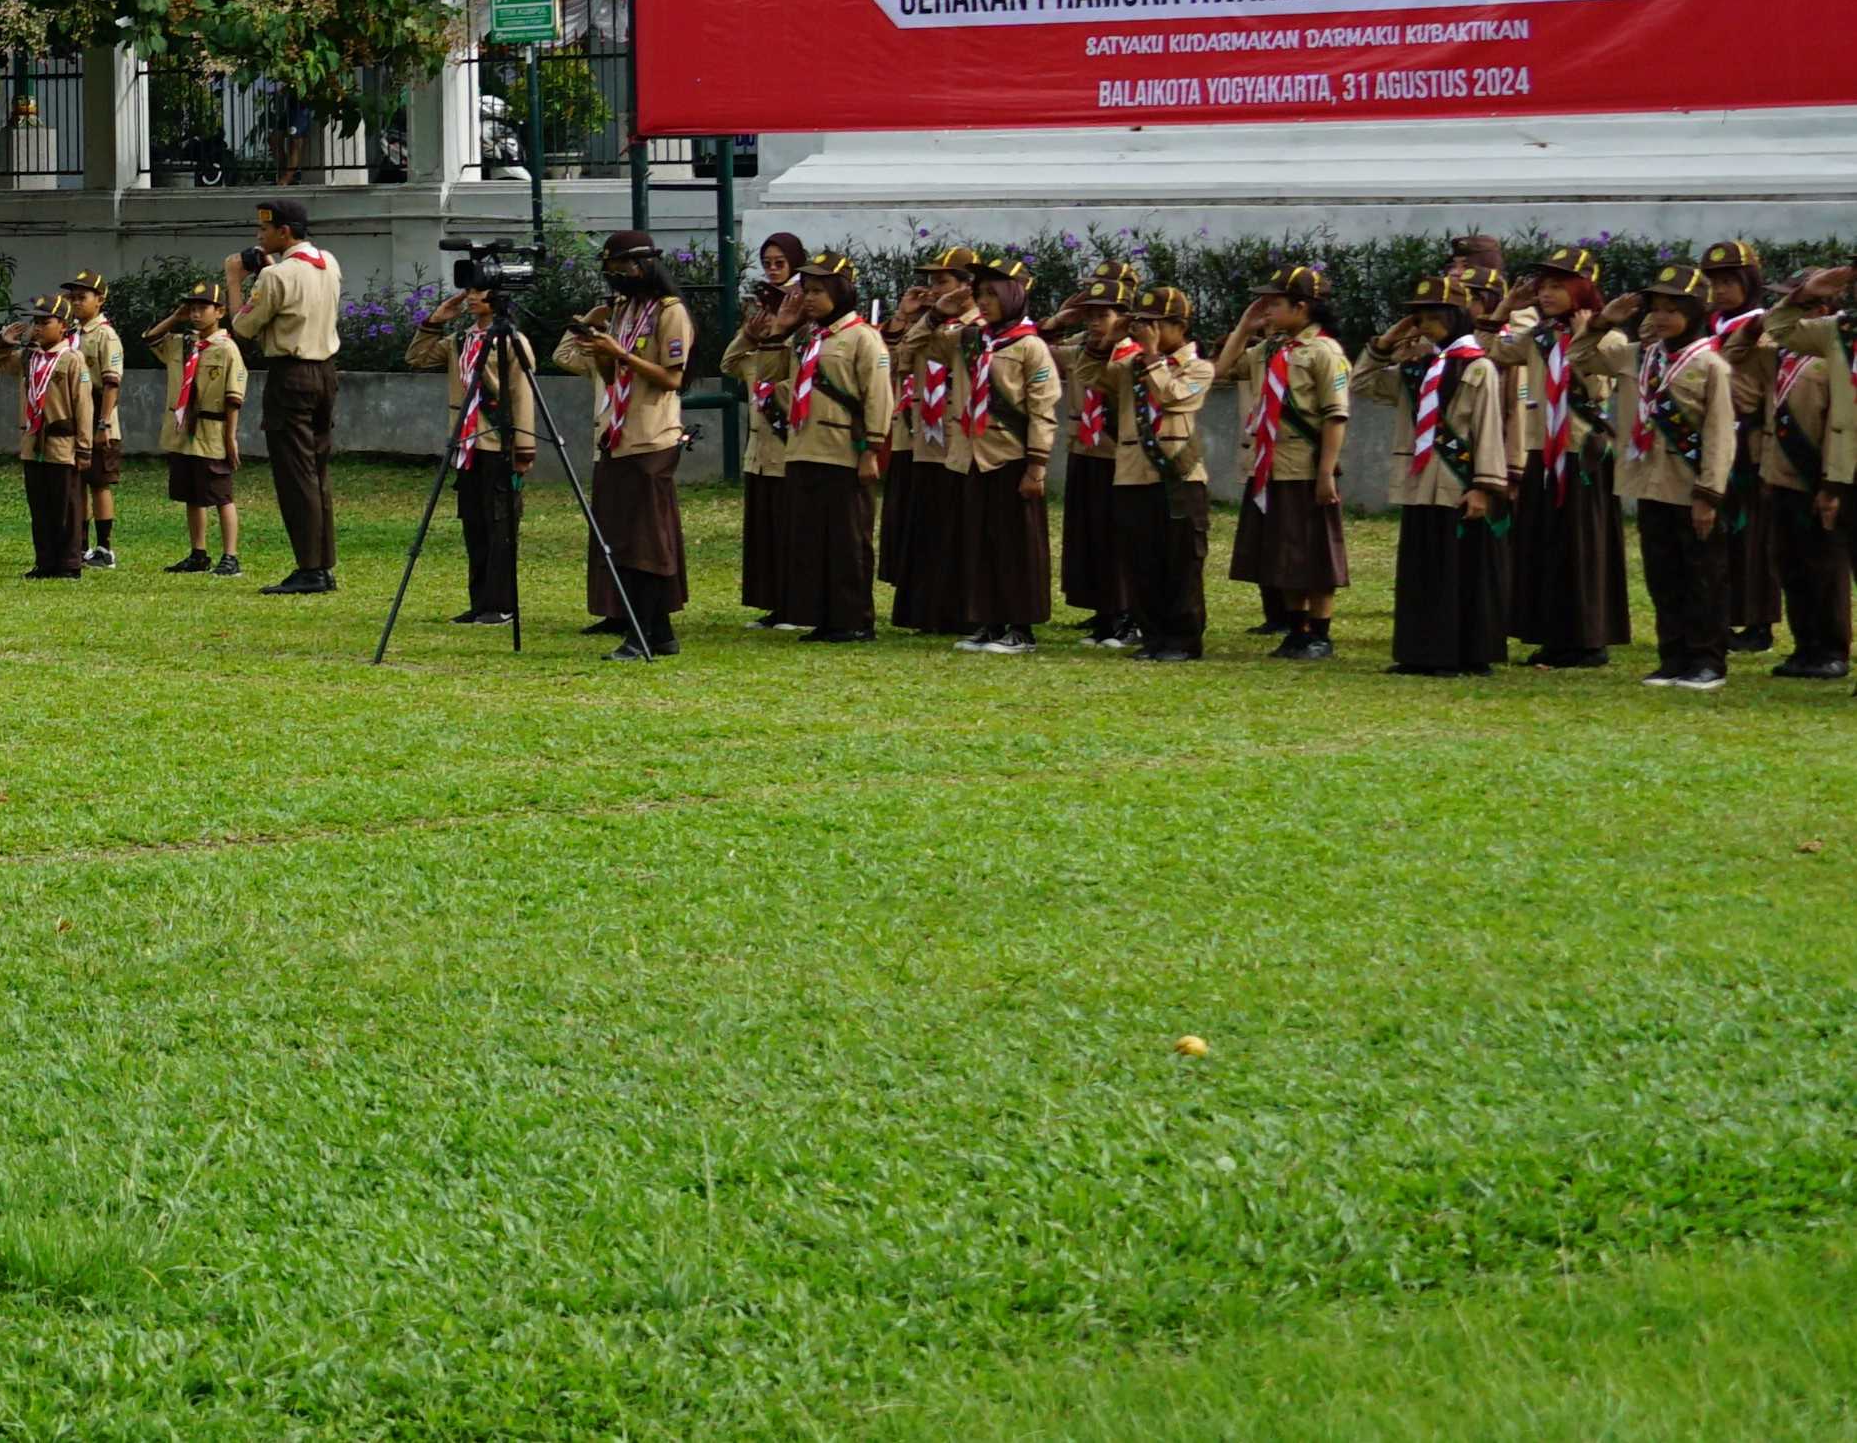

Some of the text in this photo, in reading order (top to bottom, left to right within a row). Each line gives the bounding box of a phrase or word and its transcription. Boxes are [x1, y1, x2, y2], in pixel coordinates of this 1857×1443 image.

[1085, 18, 1530, 56] SATYAKU KUDARMAKAN DARMAKU KUBAKTIKAN
[1098, 65, 1531, 108] BALAIKOTA YOGYAKARTA, 31 AGUSTUS 2024
